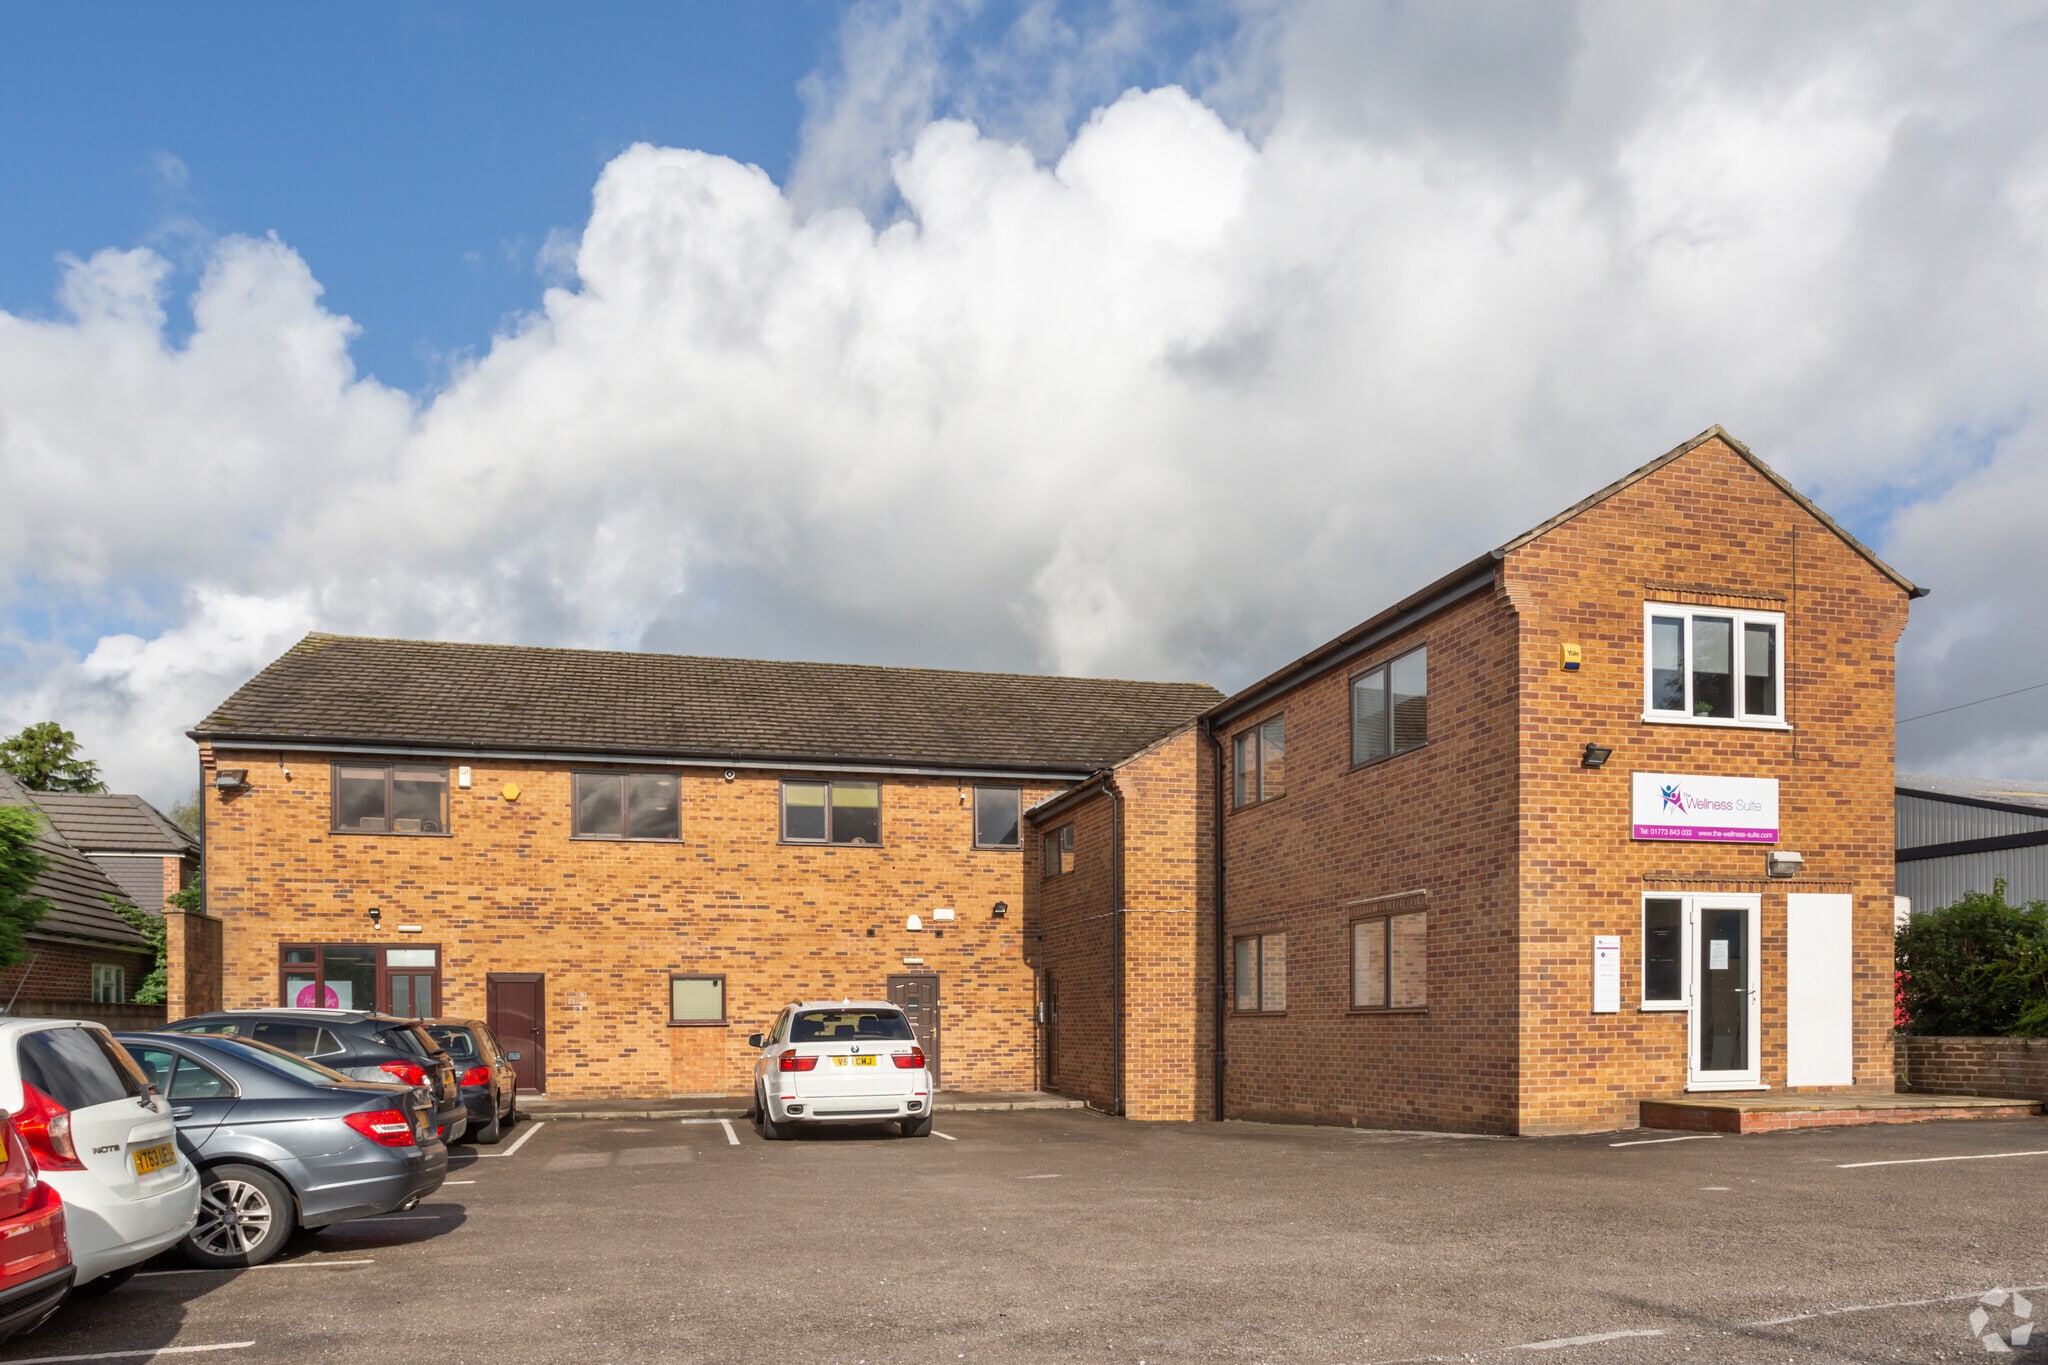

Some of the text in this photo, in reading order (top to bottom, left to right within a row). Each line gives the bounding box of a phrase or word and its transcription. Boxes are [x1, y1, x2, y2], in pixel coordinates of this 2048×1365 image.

[1686, 798, 1762, 812] Wellness Suite
[1650, 828, 1669, 836] 01773
[1669, 828, 1681, 836] 843
[1680, 829, 1693, 837] 033
[1698, 830, 1773, 838] www.the-wellness-suite.com
[855, 1057, 872, 1066] CMJ
[93, 1144, 120, 1154] NOTE
